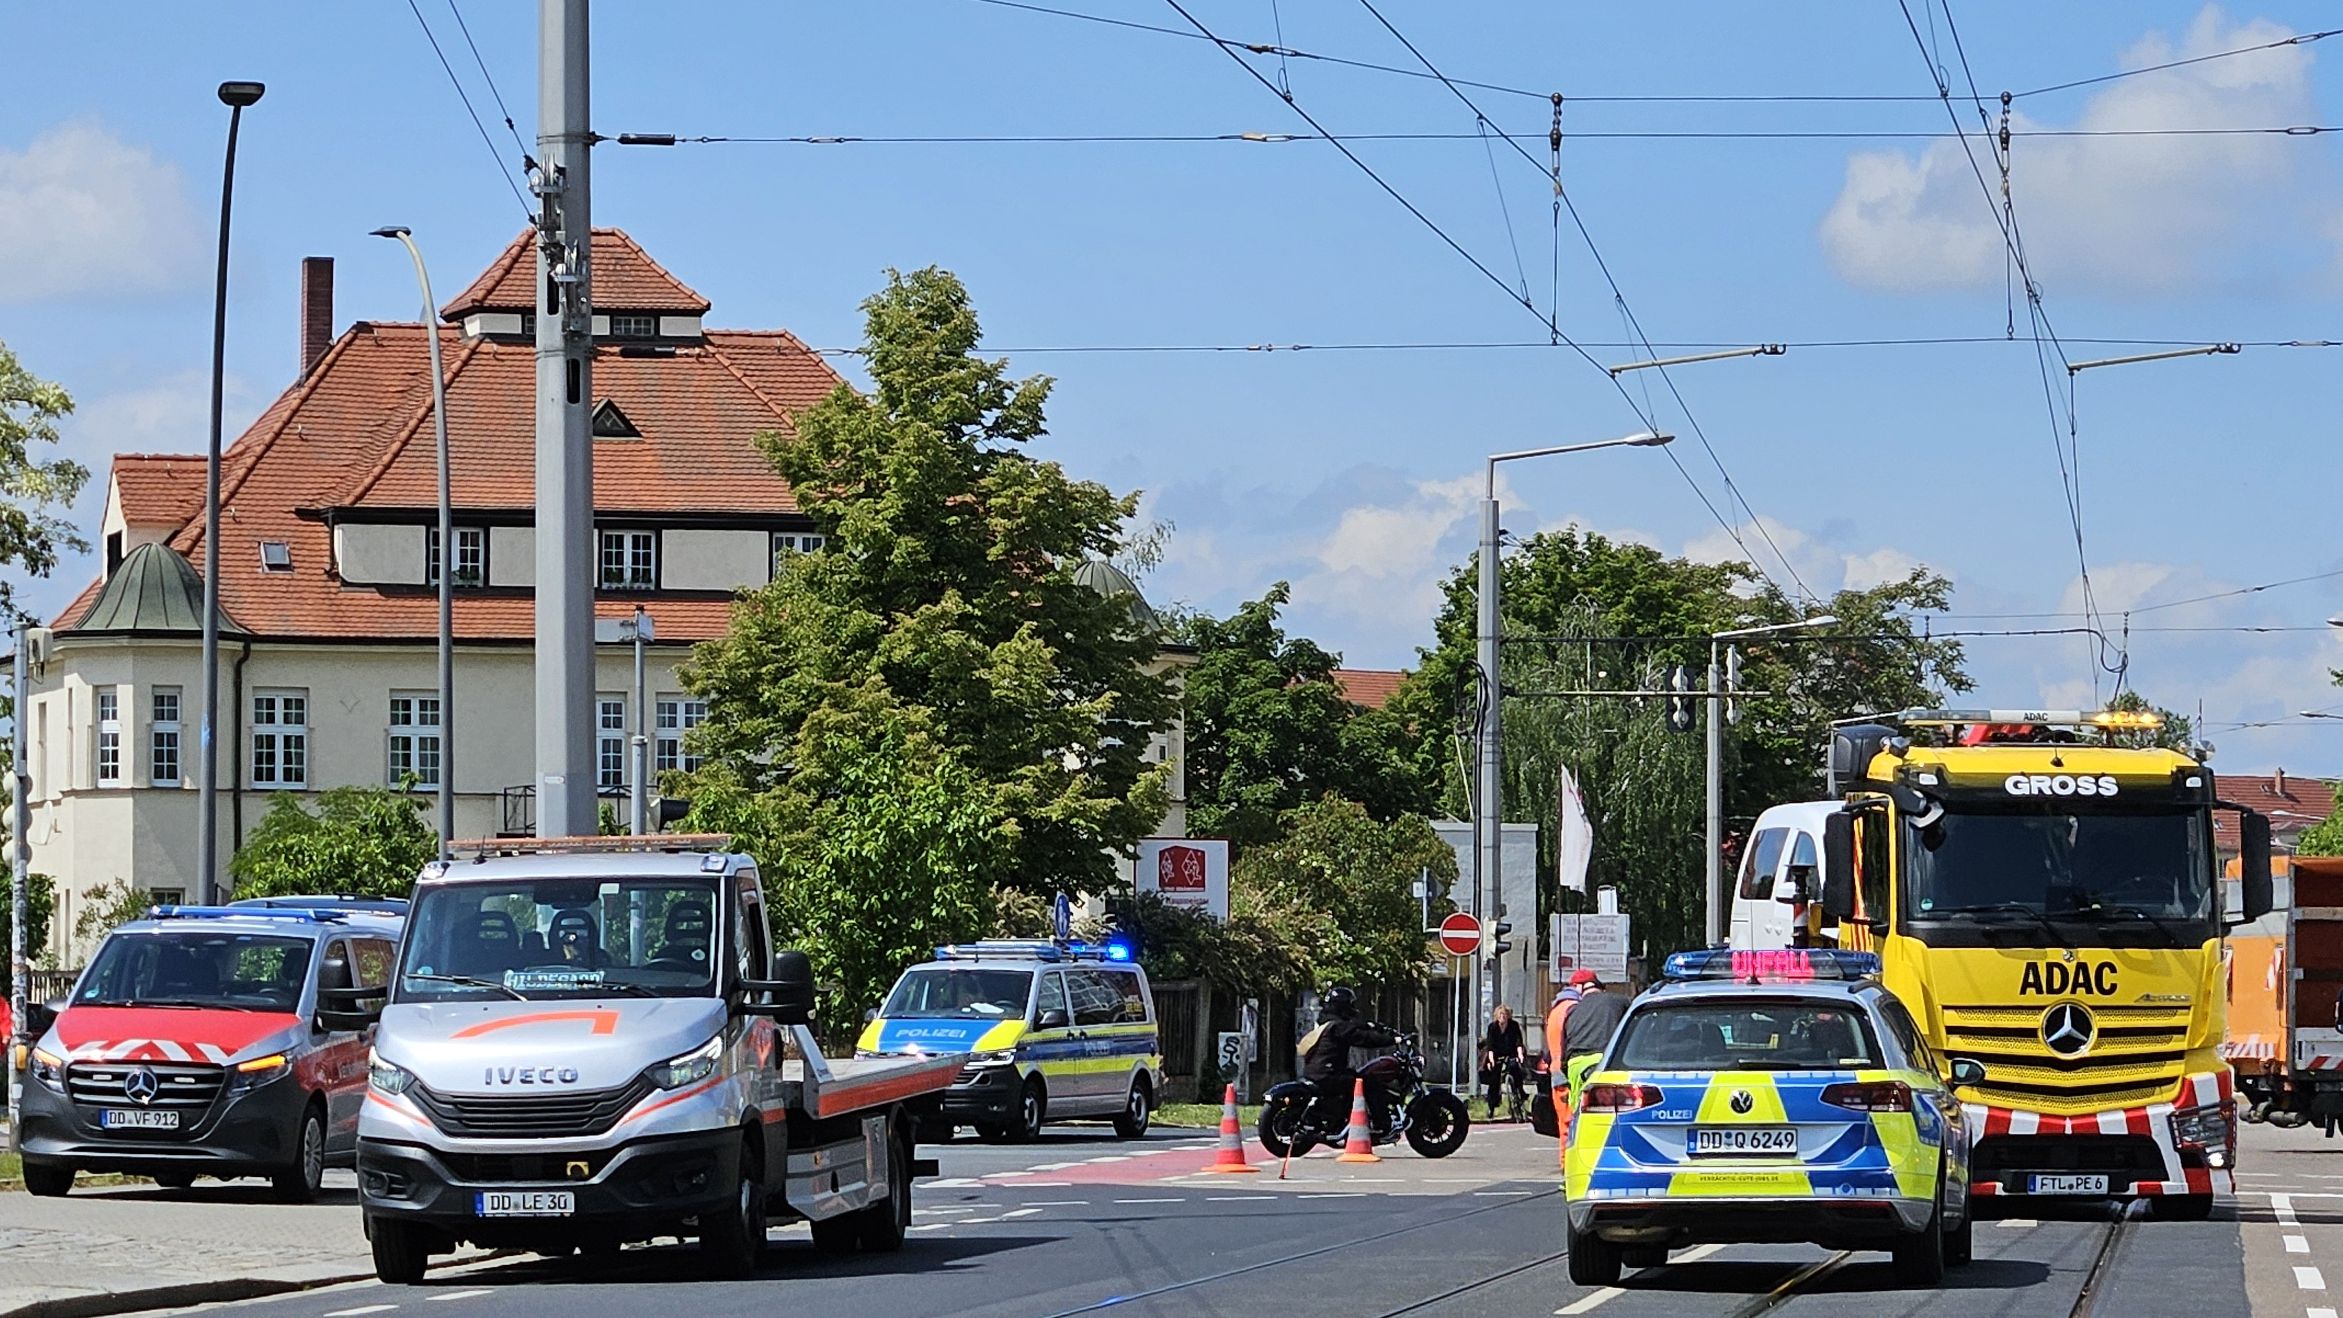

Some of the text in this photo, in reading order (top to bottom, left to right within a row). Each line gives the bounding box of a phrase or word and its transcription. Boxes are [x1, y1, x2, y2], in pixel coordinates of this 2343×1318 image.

[2023, 712, 2048, 721] ADAC
[2004, 775, 2119, 796] GROSS
[1732, 950, 1815, 977] UNFALL
[2019, 961, 2118, 996] ADAC
[896, 1028, 967, 1038] POLIZEI
[485, 1067, 578, 1085] IVECO
[109, 1112, 177, 1126] DD VF 912
[1652, 1110, 1692, 1119] POLIZEI
[1700, 1132, 1794, 1149] DD Q 6249
[2041, 1177, 2102, 1190] FTL PE 6
[491, 1194, 567, 1210] DD LE 30
